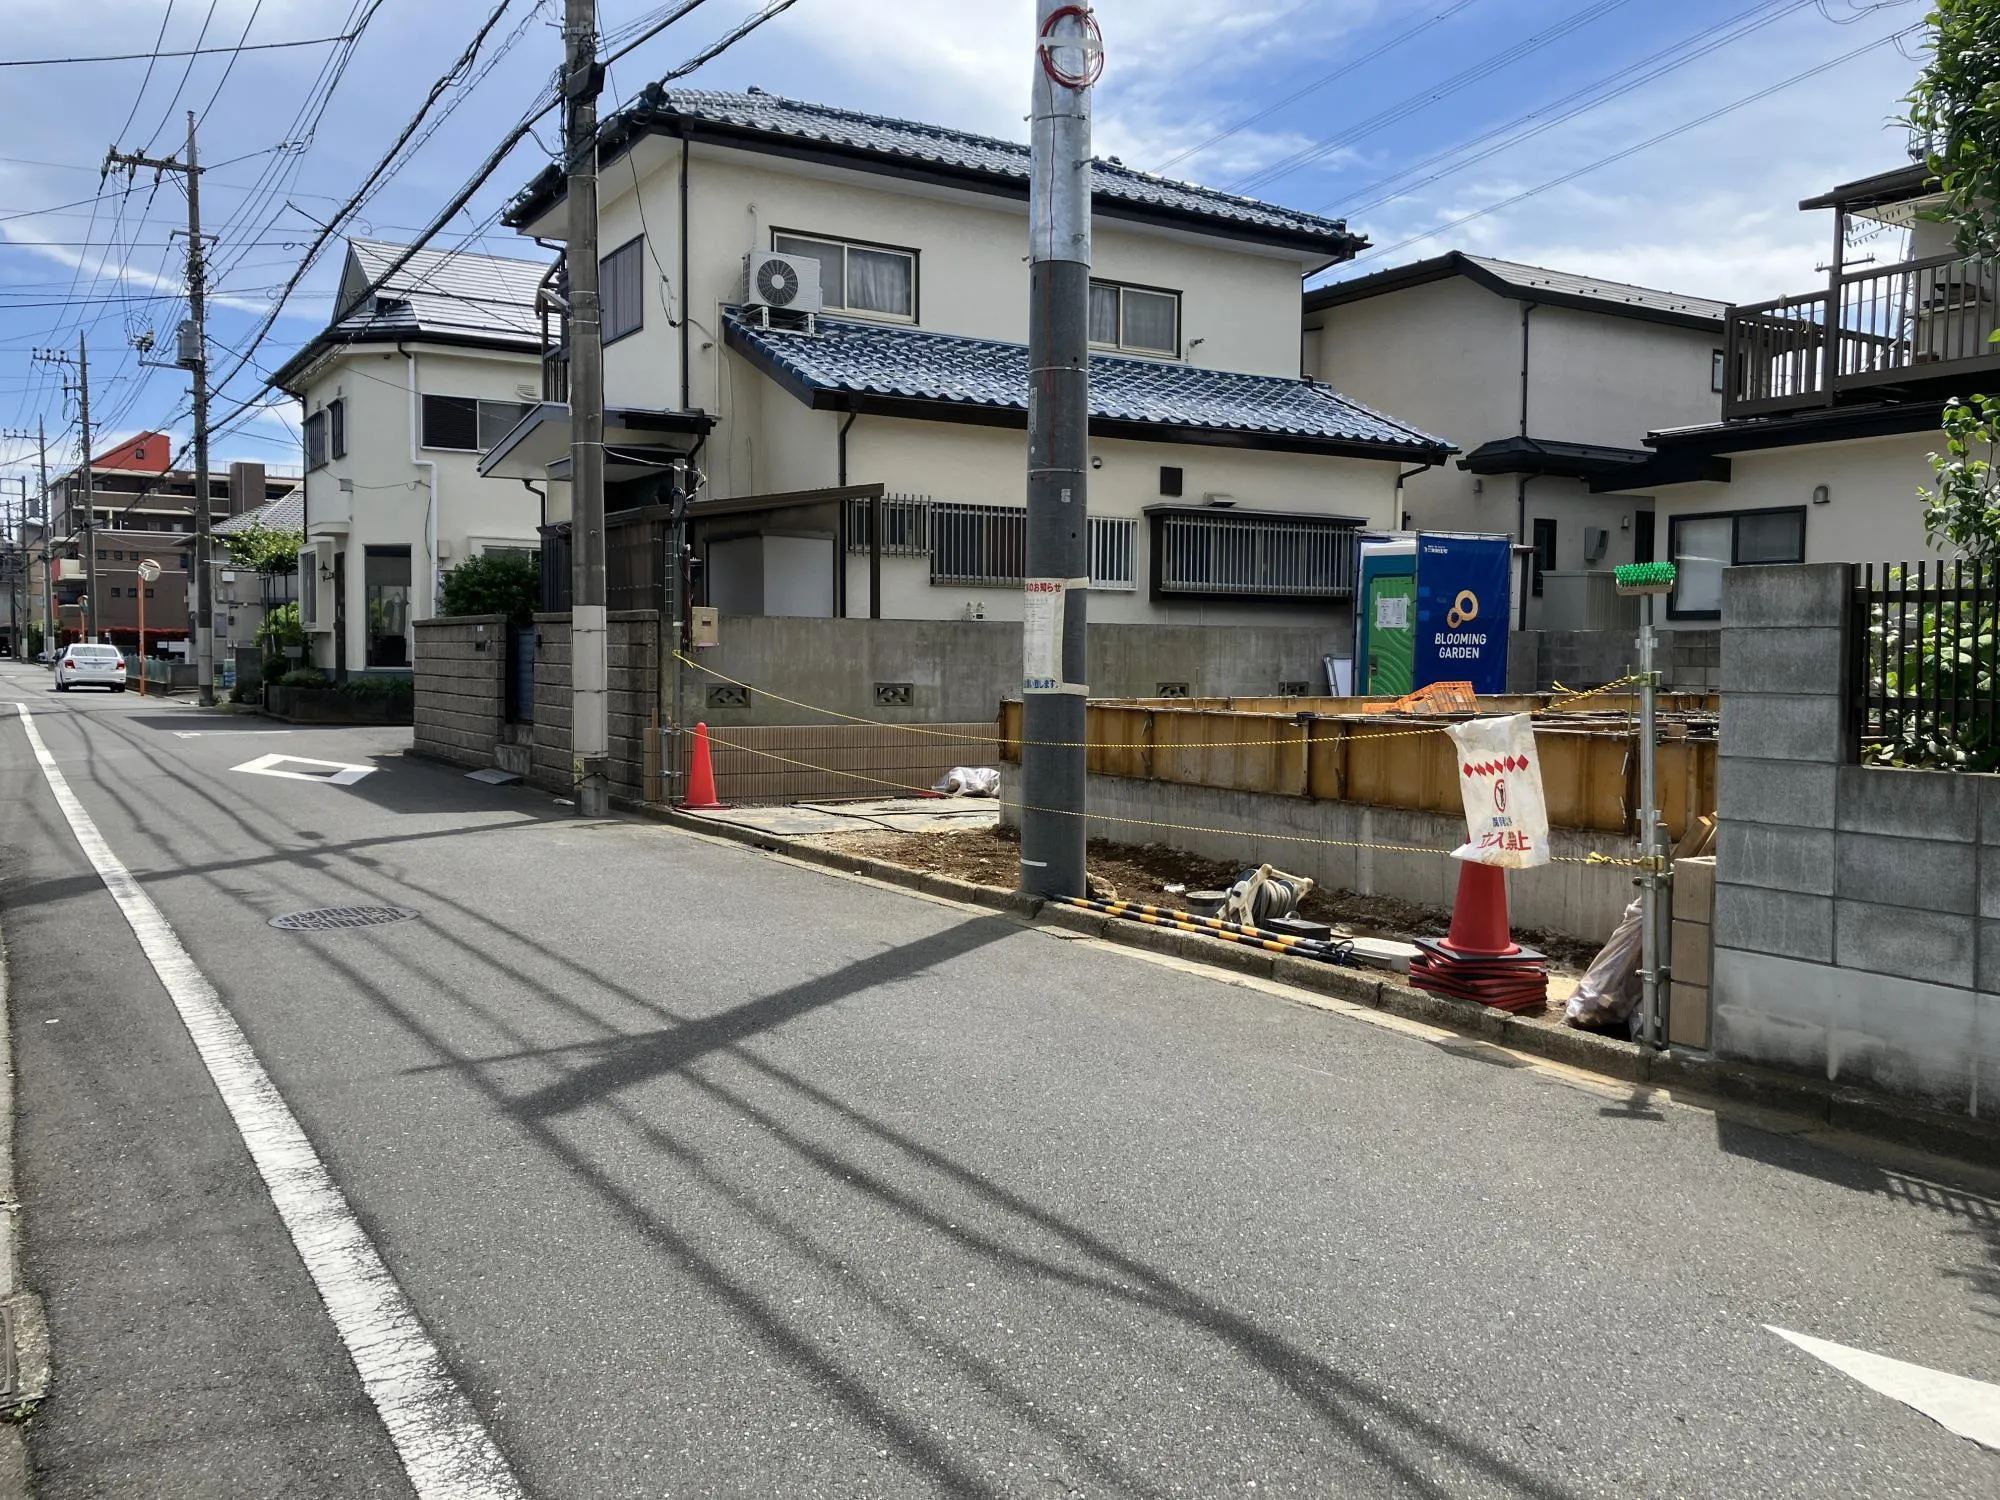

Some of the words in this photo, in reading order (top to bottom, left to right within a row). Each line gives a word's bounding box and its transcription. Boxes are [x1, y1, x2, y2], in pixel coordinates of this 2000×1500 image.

[1435, 632, 1487, 645] BLOOMING
[1439, 646, 1480, 659] GARDEN
[1476, 830, 1532, 850] 立入禁止
